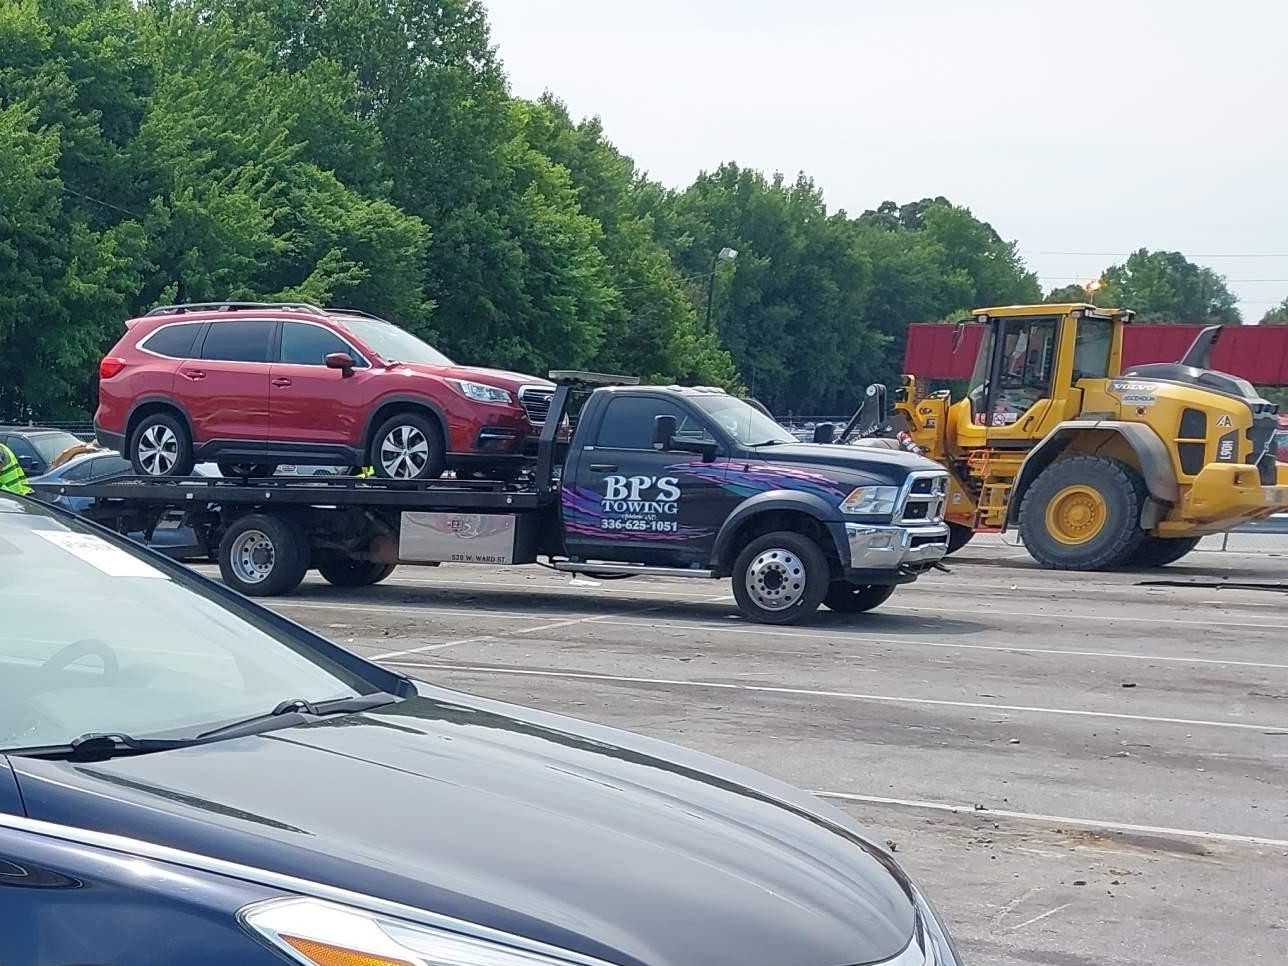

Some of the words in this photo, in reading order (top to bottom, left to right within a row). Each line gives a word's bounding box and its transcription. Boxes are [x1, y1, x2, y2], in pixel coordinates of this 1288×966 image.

[1113, 383, 1154, 391] VOLVO
[602, 475, 681, 501] BP'S
[601, 500, 680, 514] TOWING
[601, 519, 678, 532] 336-625-1051
[475, 554, 496, 563] WARD
